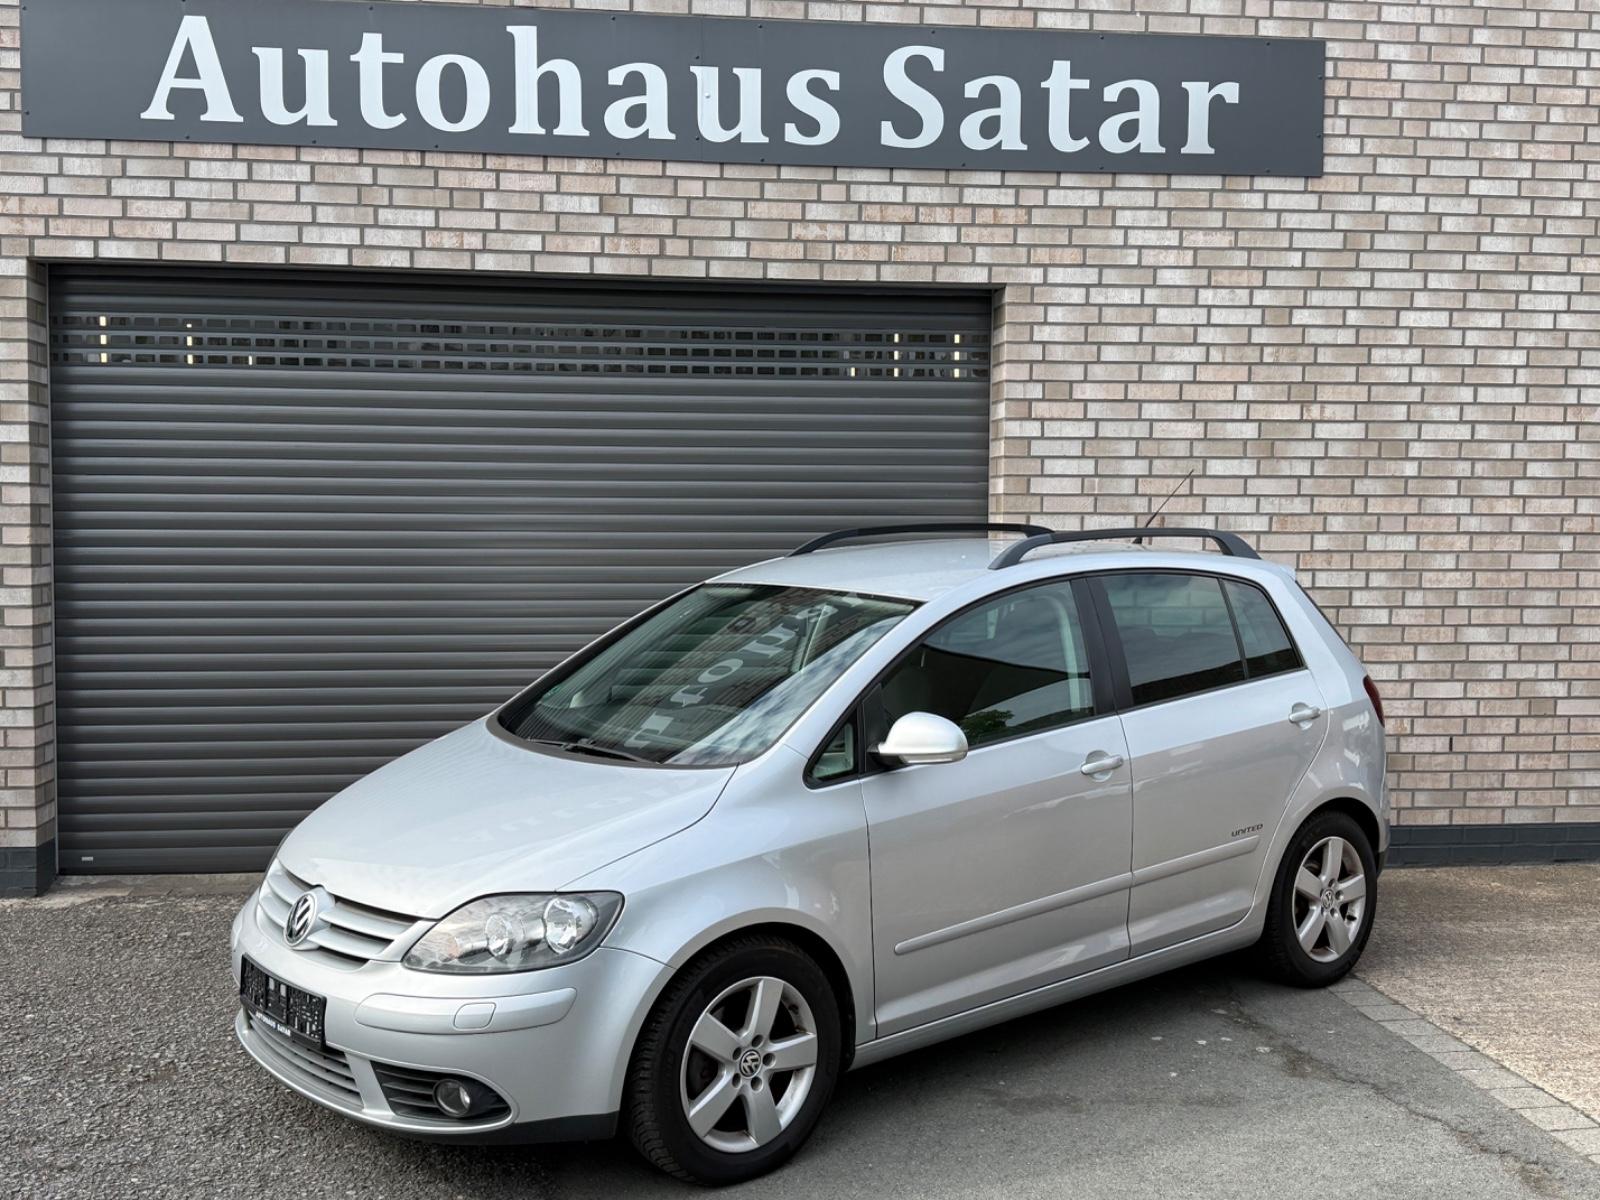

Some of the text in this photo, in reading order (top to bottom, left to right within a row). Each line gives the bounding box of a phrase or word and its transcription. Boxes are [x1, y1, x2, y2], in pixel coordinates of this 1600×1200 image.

[140, 15, 1240, 154] Autohaus Satar
[1231, 823, 1264, 837] UNITED
